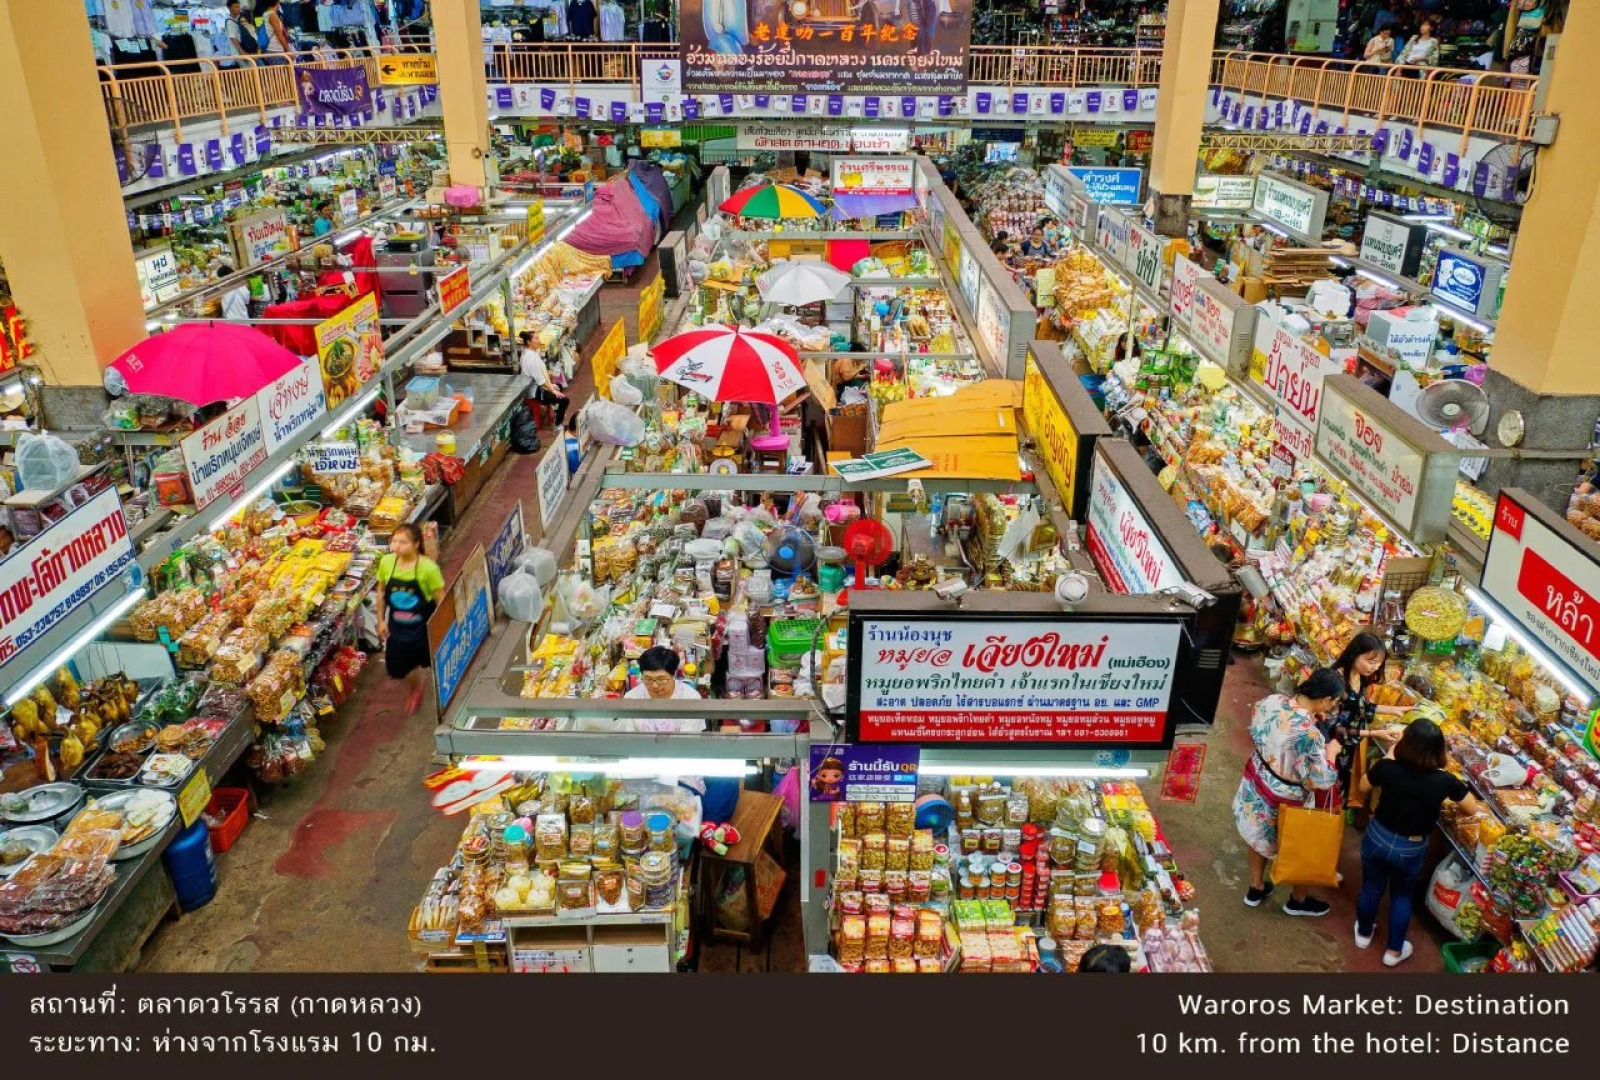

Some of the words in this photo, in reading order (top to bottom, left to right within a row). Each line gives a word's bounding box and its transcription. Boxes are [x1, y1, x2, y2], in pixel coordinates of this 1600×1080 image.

[1501, 505, 1519, 529] ร้าน
[1546, 584, 1594, 644] หล้า
[867, 625, 952, 647] ร้านน้องนุช
[877, 647, 953, 671] หมูยอ
[864, 671, 1005, 696] หมูยอพริกไทยดำ
[1010, 670, 1169, 691] เจ้าแรกในเชียงใหม่
[876, 696, 906, 707] สะอาด
[911, 694, 952, 707] ปลอดภัย
[1027, 695, 1090, 710] ผ่านมาตรฐาน
[1094, 698, 1110, 708] อย.
[1113, 697, 1131, 707] และ
[1135, 697, 1160, 708] GMP
[928, 712, 995, 727] หมูยอพริกไทยดำ
[848, 759, 899, 772] ร้านนี้รับ
[900, 763, 917, 772] QR
